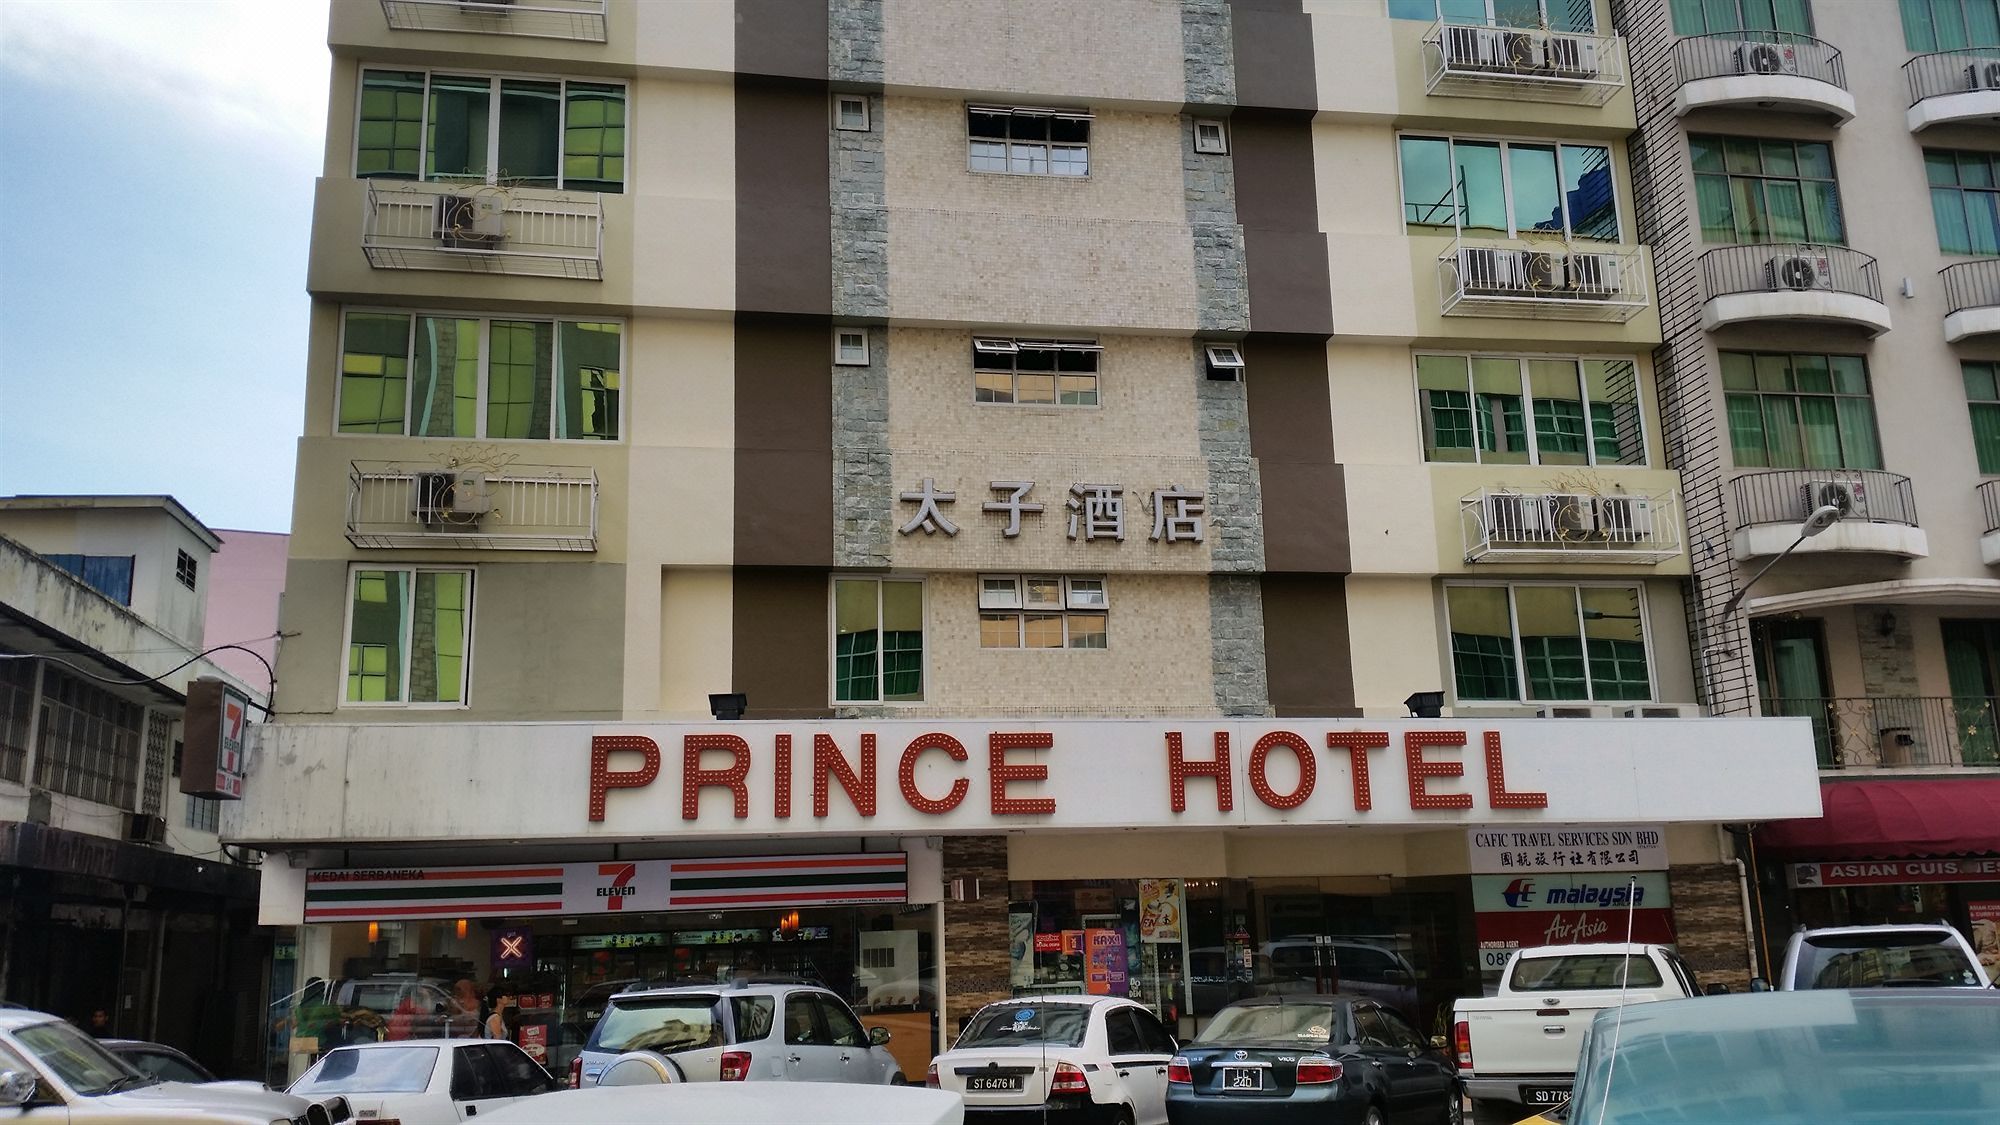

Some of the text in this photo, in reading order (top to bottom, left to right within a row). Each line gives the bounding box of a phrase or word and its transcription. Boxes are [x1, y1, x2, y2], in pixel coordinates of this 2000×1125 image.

[898, 478, 1205, 543] 太子酒店
[589, 730, 1548, 822] PRINCE HOTEL
[1475, 831, 1659, 848] CAFIC TRAVEL SERVICES SDN BHD
[313, 869, 425, 882] KEDAI SERBANEKA
[1830, 860, 2000, 878] ASIAN CUISE
[598, 863, 636, 910] 7
[1546, 882, 1645, 908] malaysia
[974, 1078, 984, 1089] ST
[986, 1078, 1008, 1089] 6476
[1233, 1077, 1252, 1088] 240
[1535, 1090, 1572, 1102] SD 778
